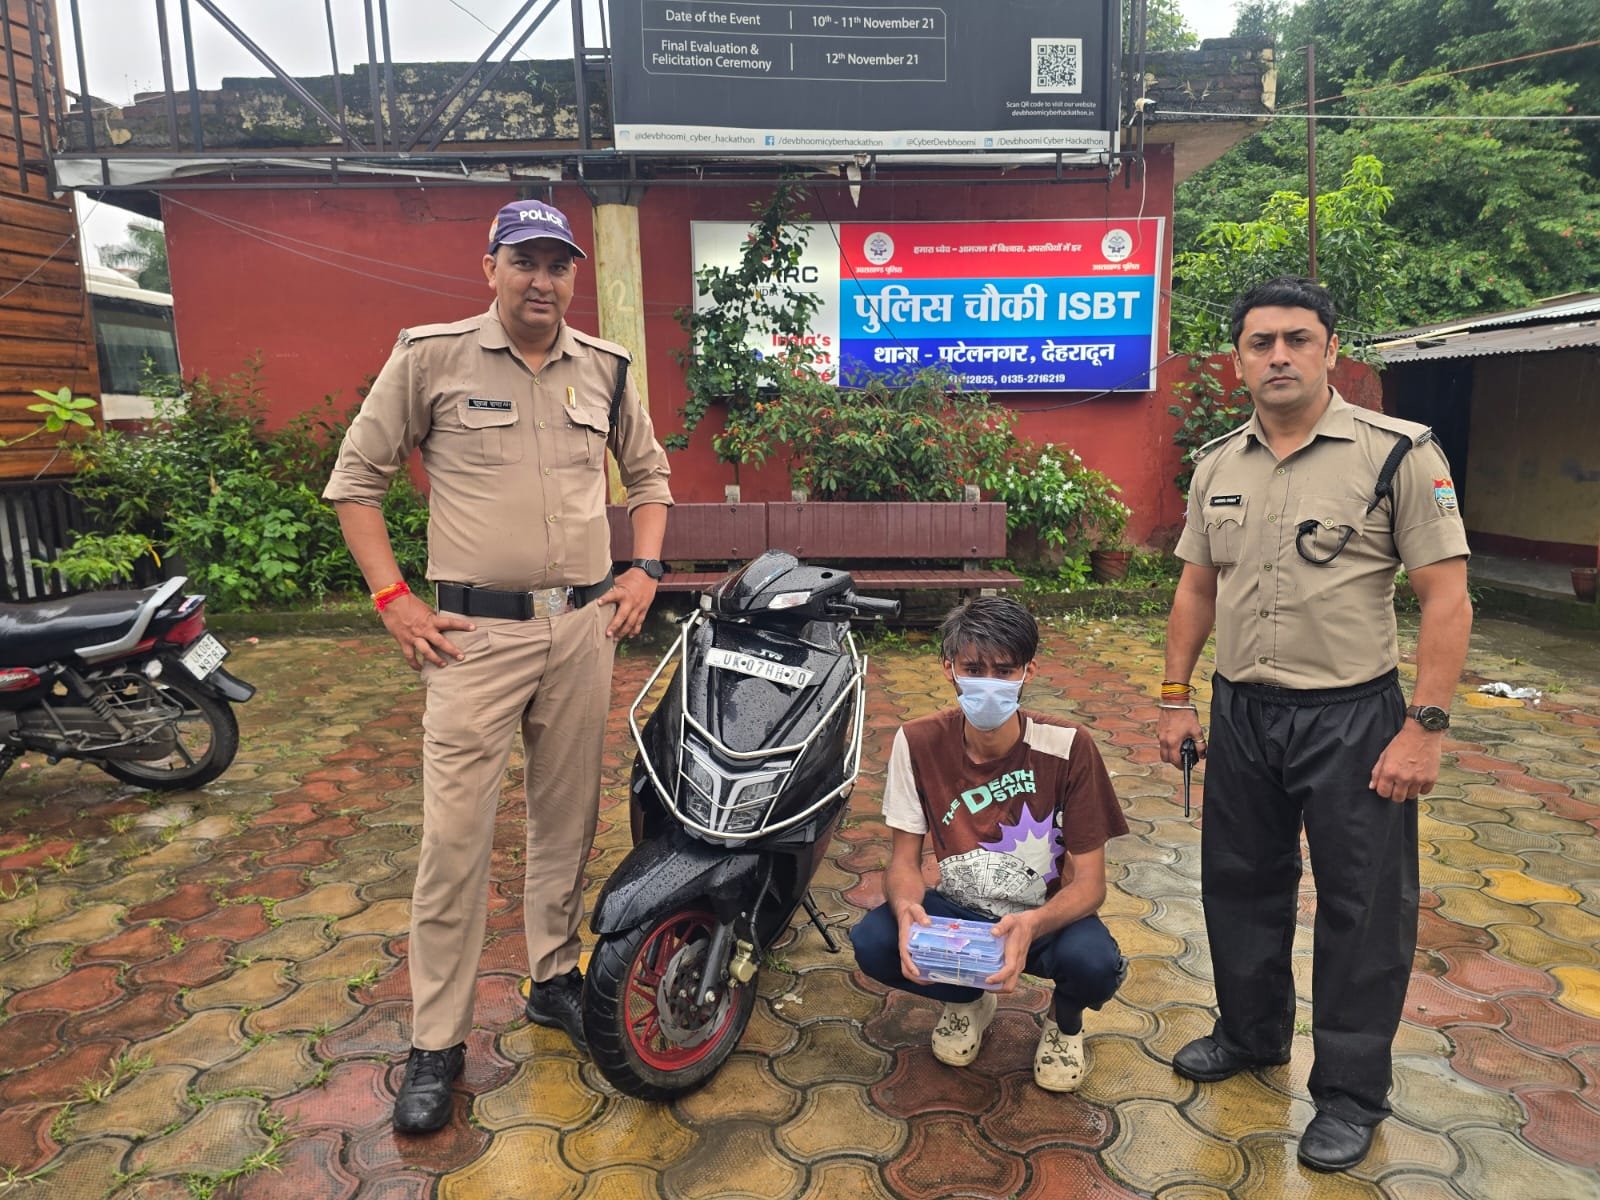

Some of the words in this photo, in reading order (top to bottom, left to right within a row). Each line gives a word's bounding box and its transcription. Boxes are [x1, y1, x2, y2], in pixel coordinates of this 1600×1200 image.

[666, 9, 692, 21] Date
[694, 10, 707, 22] of
[708, 11, 727, 23] the
[729, 12, 761, 25] Event
[812, 15, 832, 27] 10th
[842, 16, 861, 28] 11th
[863, 17, 920, 29] November
[922, 18, 934, 29] 21
[661, 39, 687, 52] Final
[690, 41, 748, 54] Evaluation
[750, 43, 759, 55] &
[652, 52, 713, 67] Felicitation
[715, 56, 772, 72] Ceremony
[826, 53, 846, 64] 12th
[847, 53, 904, 65] November
[906, 54, 919, 65] 21
[1030, 100, 1044, 108] code
[1043, 137, 1064, 147] Cyber
[1065, 137, 1104, 147] Hackathon
[852, 284, 954, 334] पुलिस
[963, 283, 1048, 323] चौकी
[1058, 290, 1141, 322] ISBT
[873, 344, 919, 365] थाना
[938, 340, 1037, 365] पटेलनगर,
[1041, 339, 1116, 367] देहरादून
[1001, 374, 1066, 384] 0135-2716219
[942, 799, 961, 826] THE
[961, 769, 1036, 815] DEATH
[993, 781, 1037, 802] STAR
